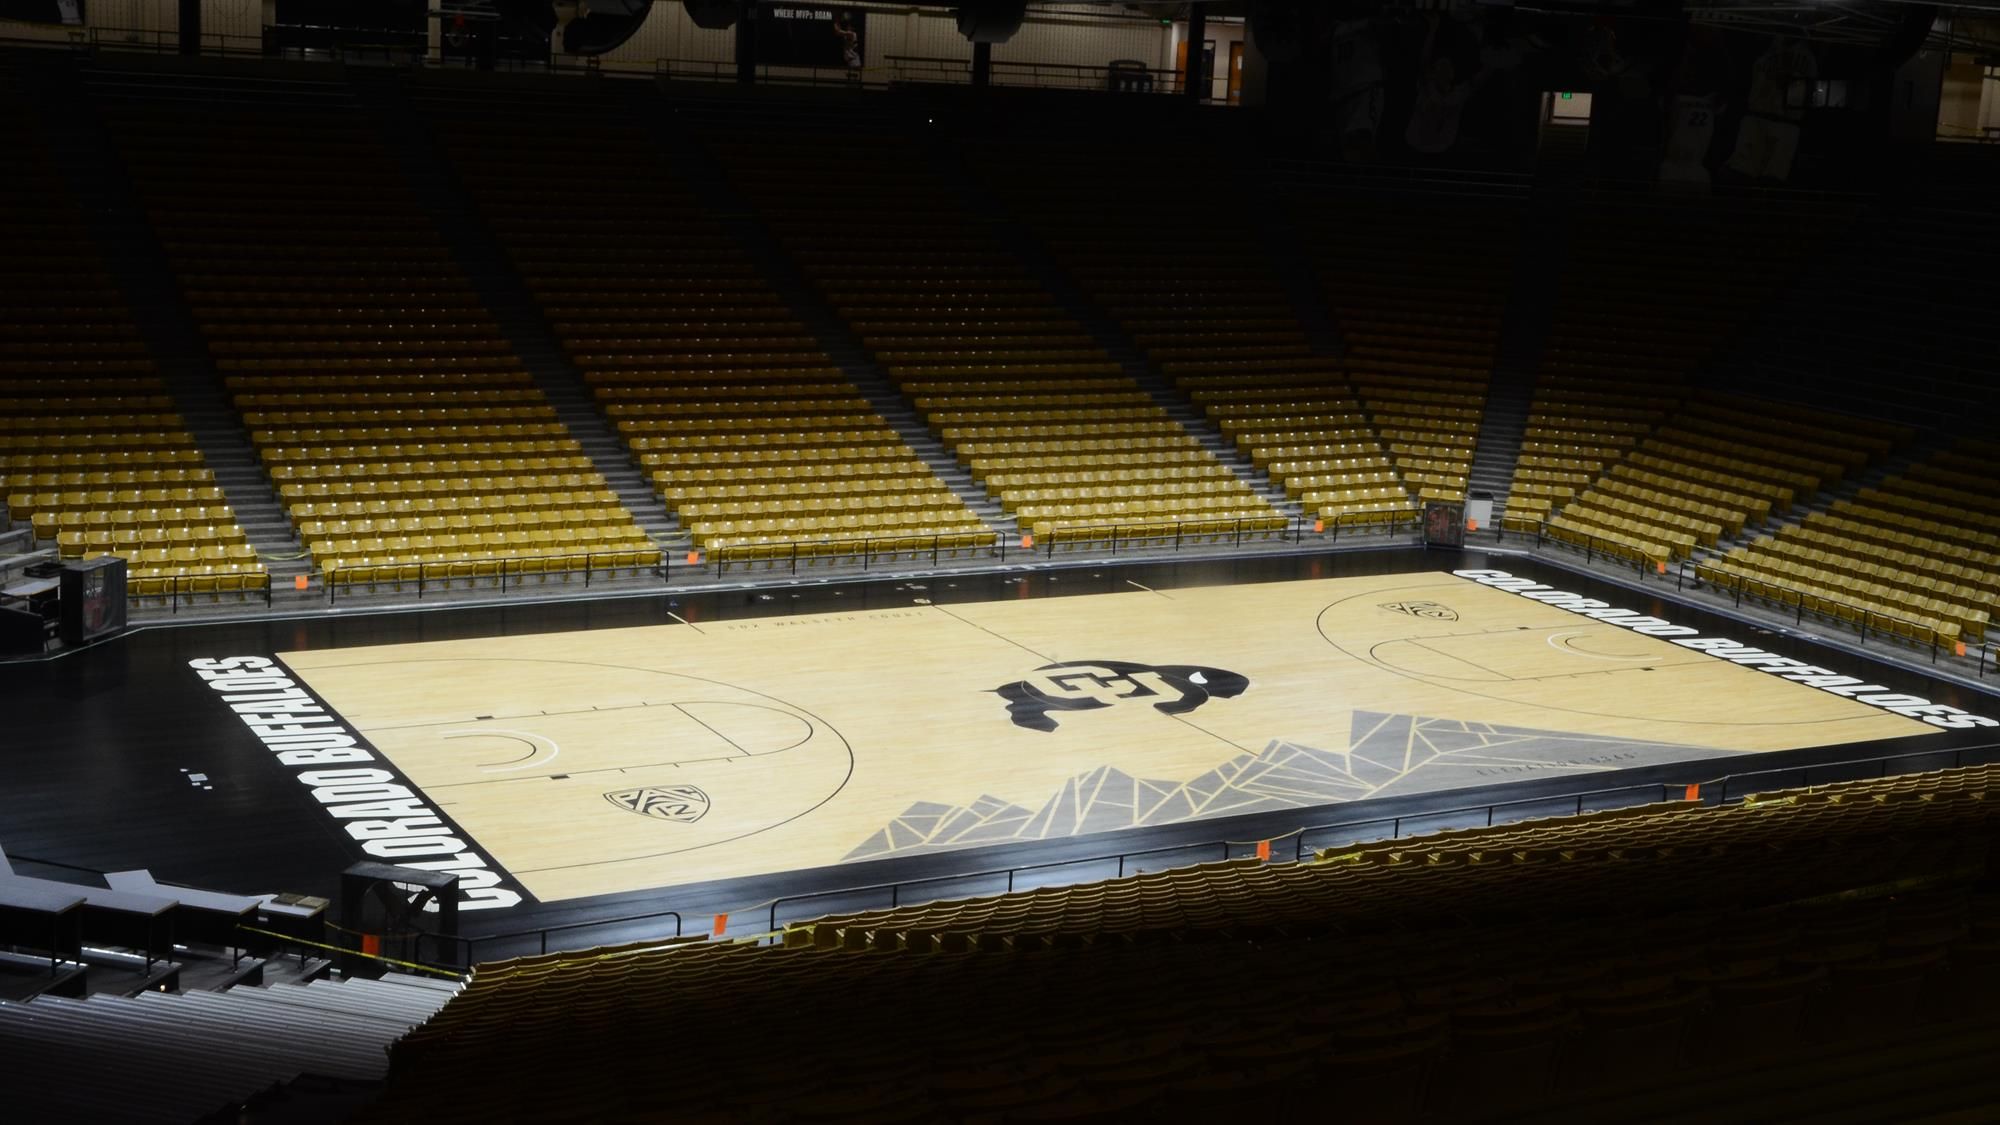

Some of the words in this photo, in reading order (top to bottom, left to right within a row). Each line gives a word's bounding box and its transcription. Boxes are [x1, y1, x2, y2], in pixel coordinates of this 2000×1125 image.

[773, 8, 794, 18] WHERE
[814, 10, 832, 20] ROAM
[1453, 569, 1700, 636] COLORADO
[1669, 637, 2000, 729] BUFFALOES
[188, 655, 376, 766] BUFFALOES
